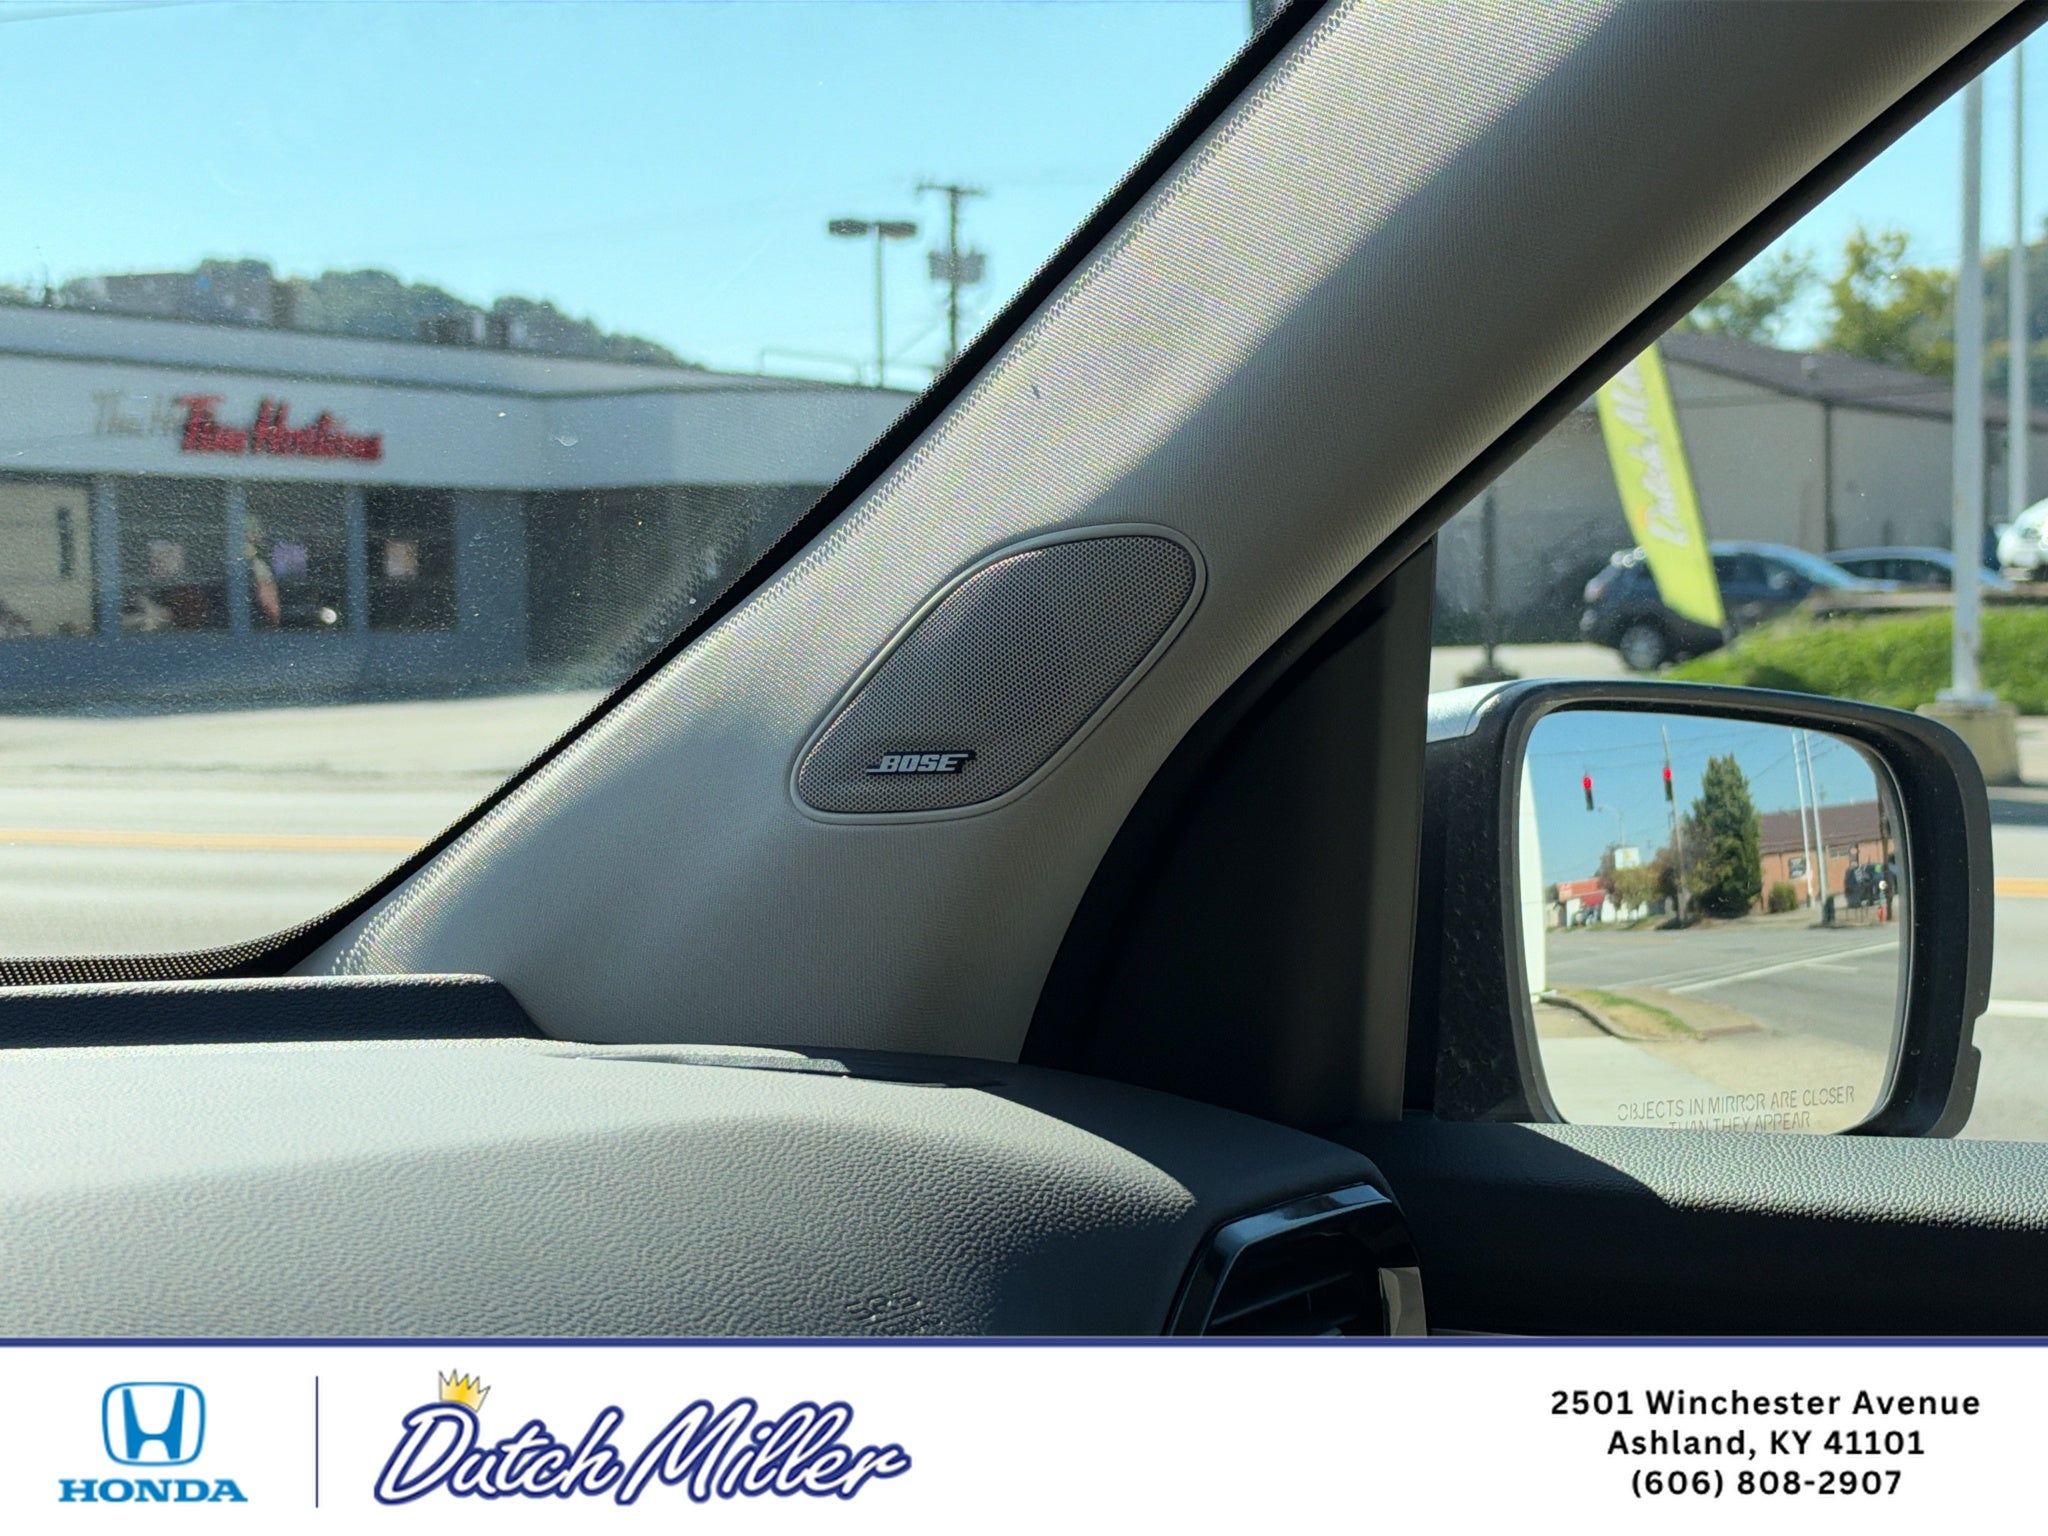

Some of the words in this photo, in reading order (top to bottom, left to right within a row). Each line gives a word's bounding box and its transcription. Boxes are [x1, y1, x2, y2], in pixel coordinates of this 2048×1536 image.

[865, 753, 969, 773] BOSE
[1617, 1098, 1685, 1121] OBJECTS
[1688, 1097, 1705, 1116] IN
[1707, 1092, 1766, 1115] MIRROR
[1770, 1089, 1798, 1110] ARE
[1802, 1085, 1855, 1107] CLOSER
[1713, 1116, 1750, 1133] THEY
[1753, 1110, 1811, 1132] APPEAR
